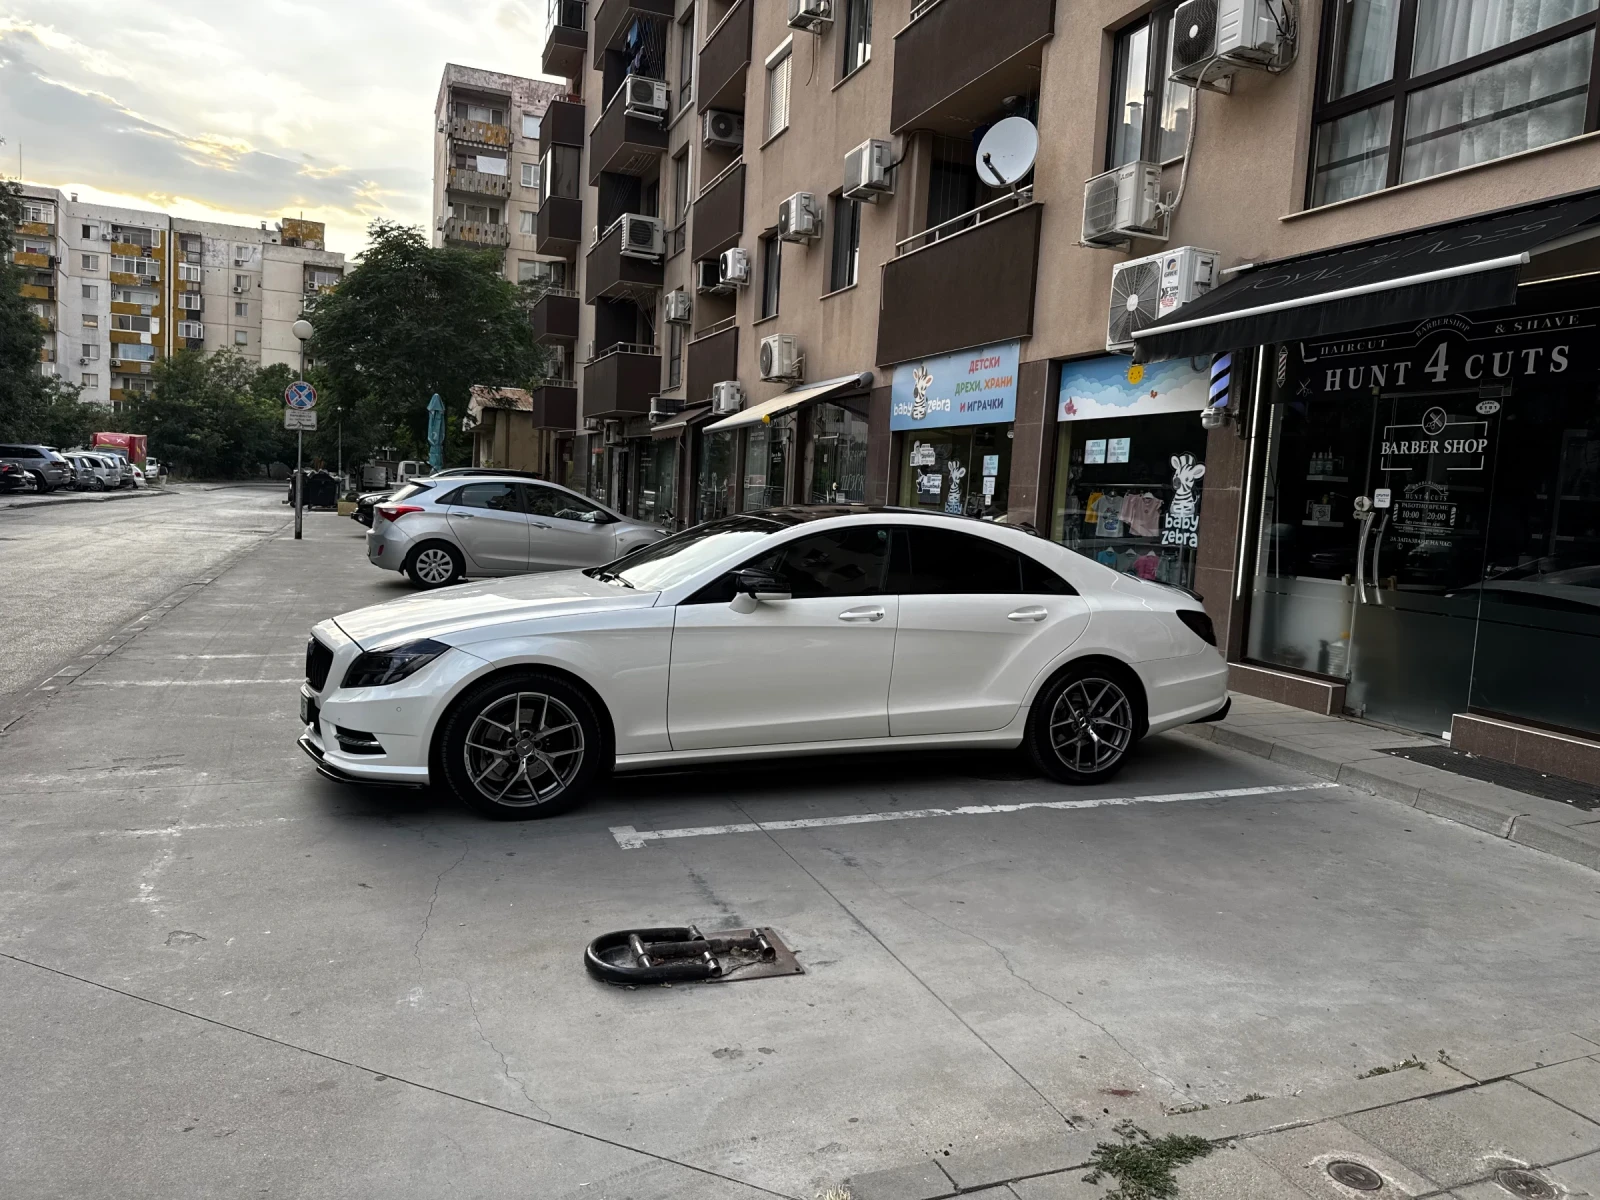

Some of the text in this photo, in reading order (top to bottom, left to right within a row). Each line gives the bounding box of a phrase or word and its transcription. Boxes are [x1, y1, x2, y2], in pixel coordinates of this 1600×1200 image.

[1415, 317, 1470, 338] BARBERSHOP
[1494, 314, 1580, 335] & SHAVE
[1320, 339, 1388, 356] HAIRCUT
[968, 355, 1001, 375] ДЕТСКИ
[1323, 341, 1570, 392] HUNT 4 CUTS
[954, 375, 1013, 397] ДРЕХИ, ХРАНИ
[893, 397, 951, 417] baby zebra
[966, 398, 1005, 412] ИГРАЧКИ
[1380, 438, 1489, 455] BARBER SHOP
[1423, 491, 1429, 501] 4
[1430, 494, 1447, 502] CUTS
[945, 502, 963, 515] baby
[1402, 510, 1420, 519] 10:00
[1426, 511, 1446, 521] 20:00
[1165, 512, 1200, 532] baby
[1161, 528, 1198, 549] zebra
